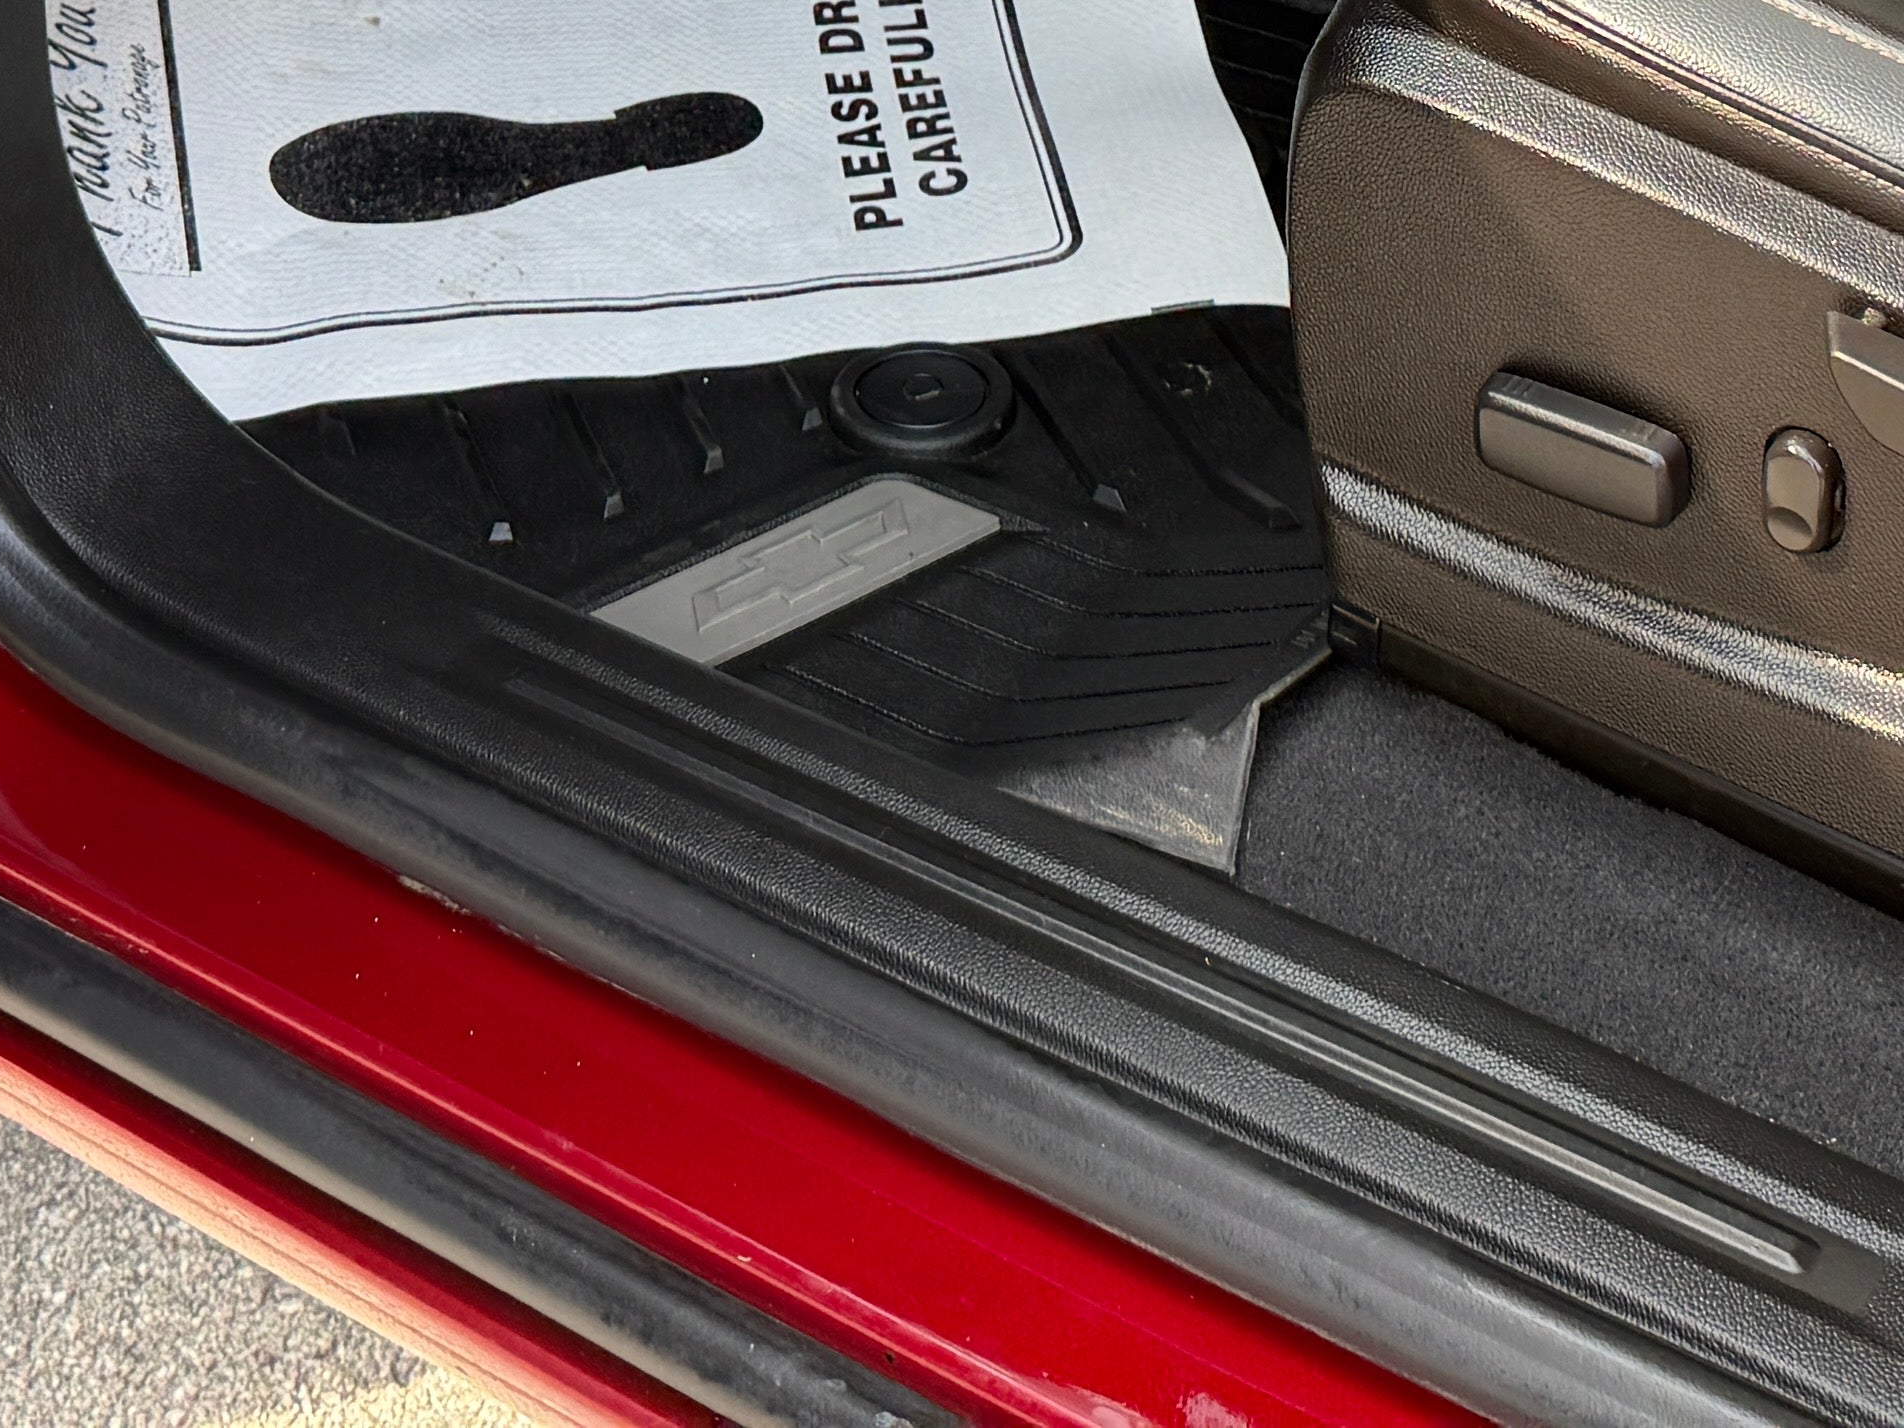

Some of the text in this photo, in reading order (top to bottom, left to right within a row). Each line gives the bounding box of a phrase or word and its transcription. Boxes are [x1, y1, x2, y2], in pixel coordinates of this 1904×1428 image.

[46, 2, 109, 71] You
[122, 42, 164, 213] For Your Patronage
[825, 69, 905, 232] PLEASE
